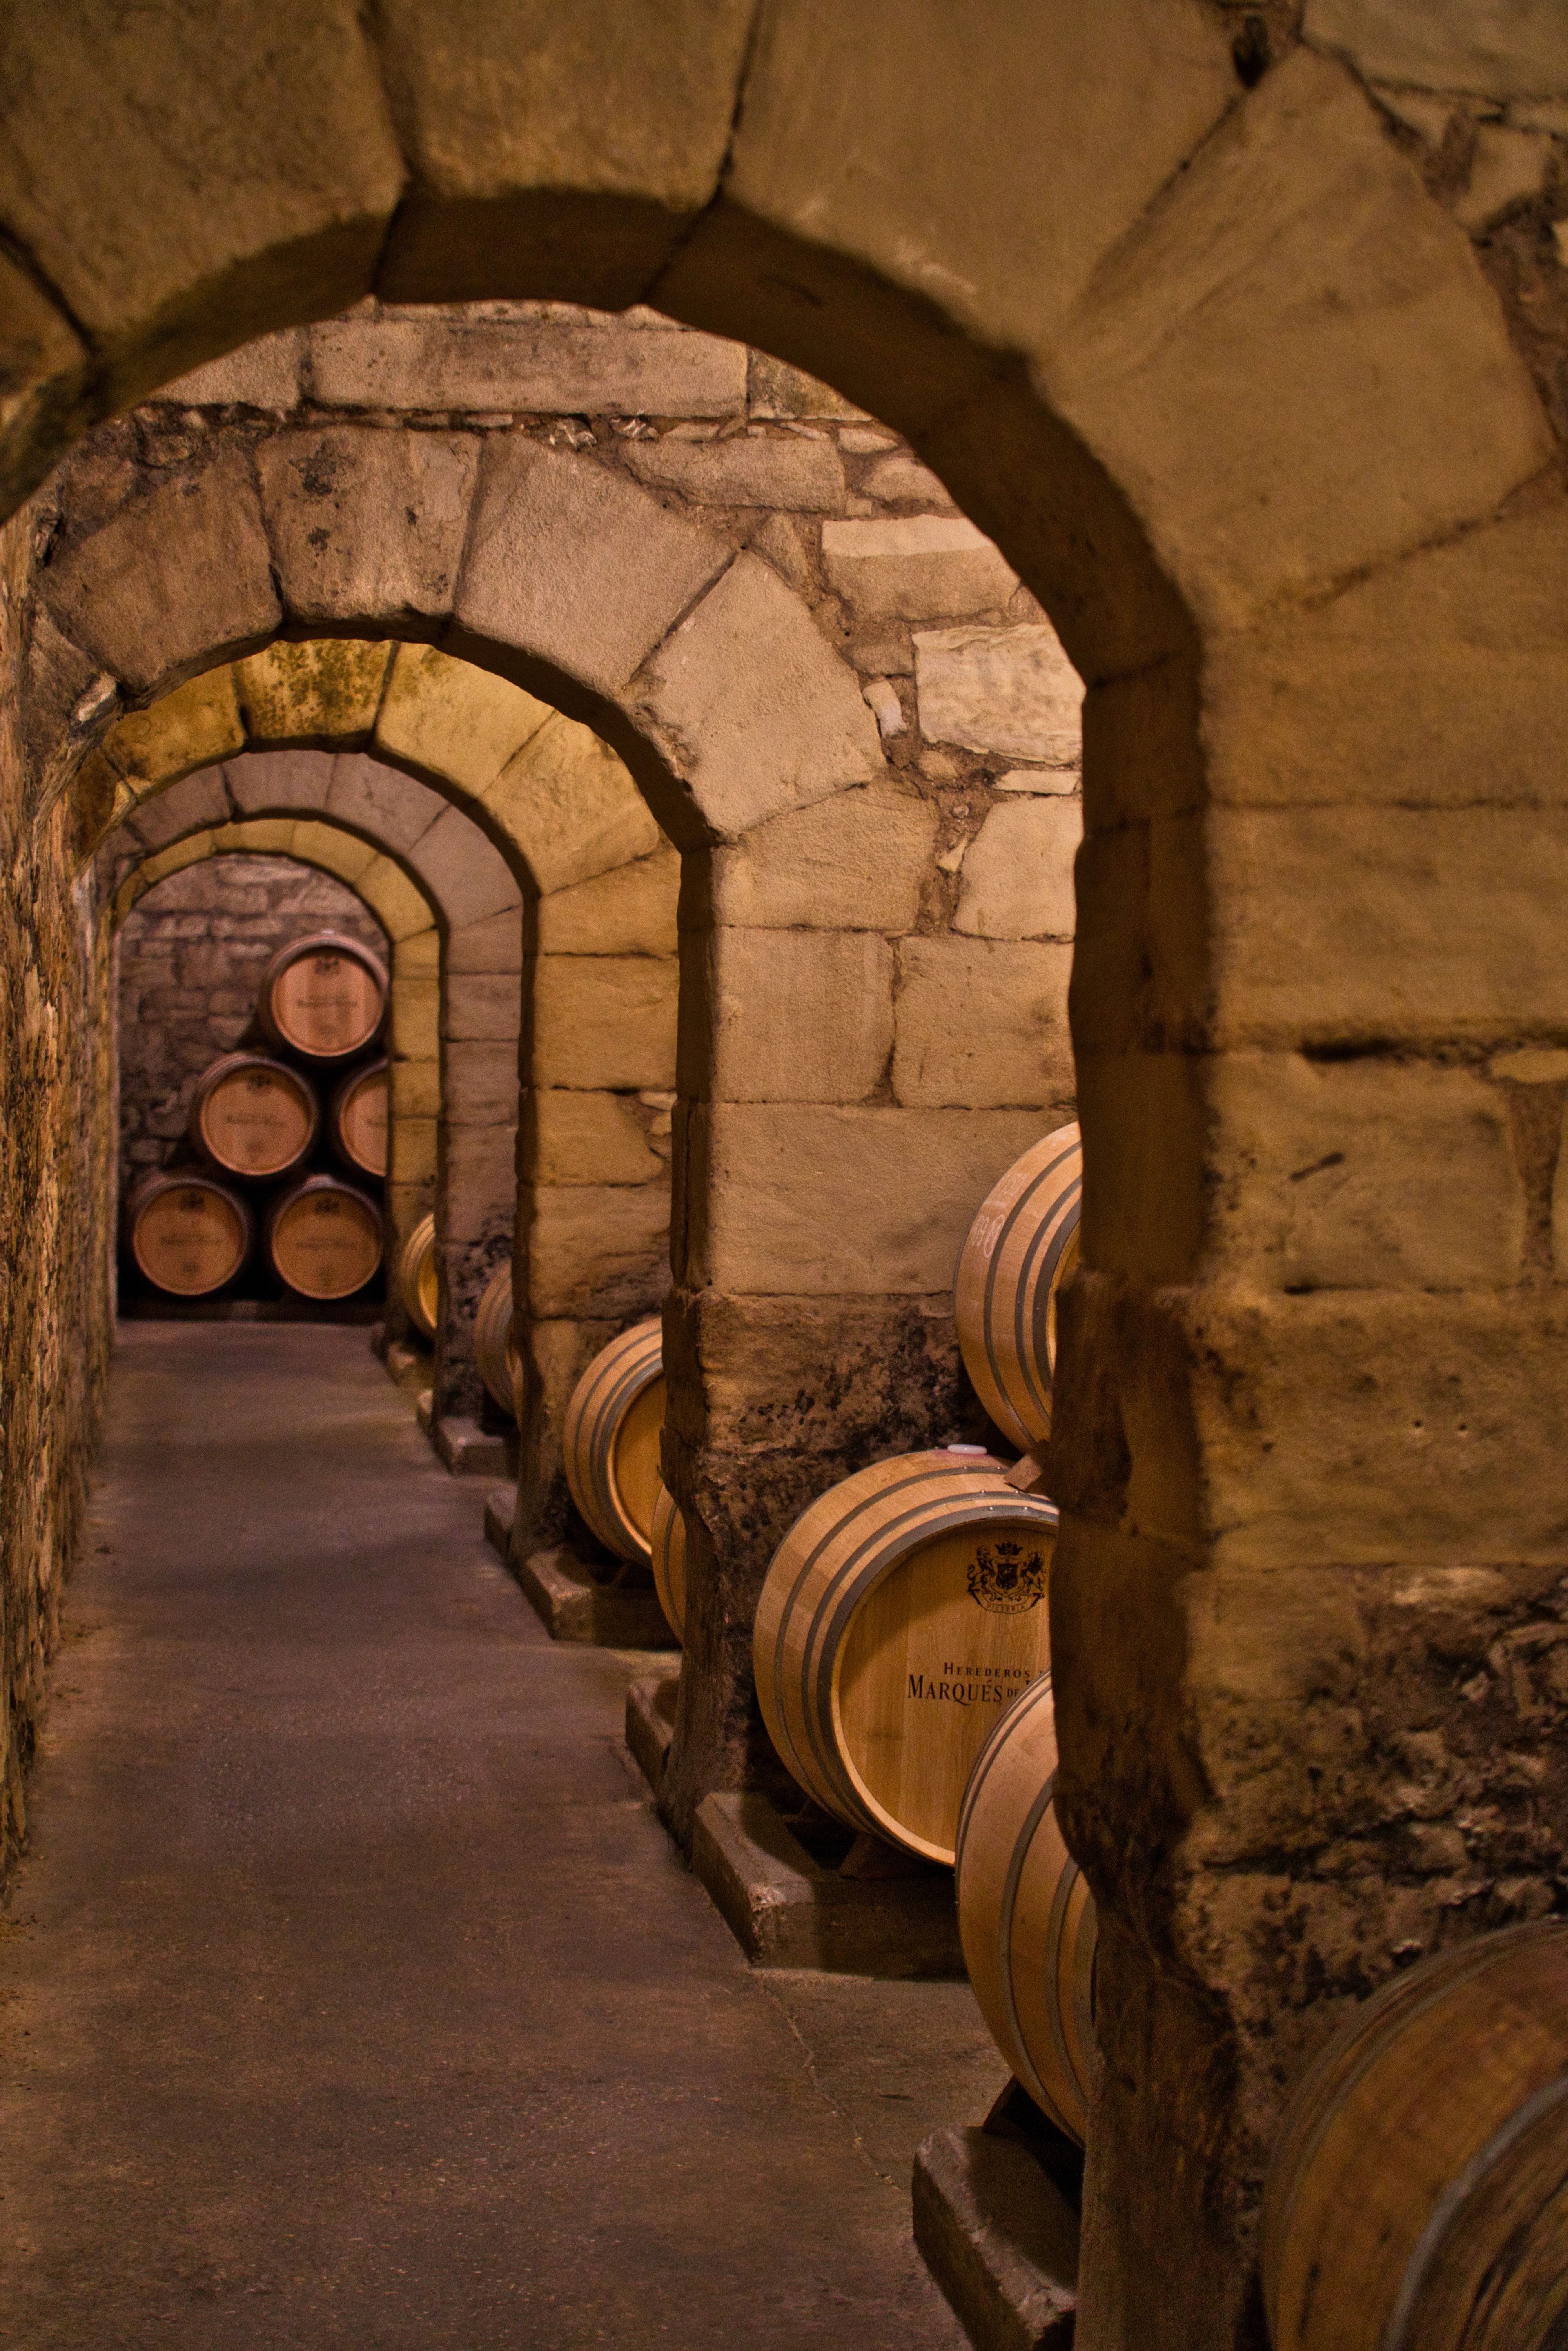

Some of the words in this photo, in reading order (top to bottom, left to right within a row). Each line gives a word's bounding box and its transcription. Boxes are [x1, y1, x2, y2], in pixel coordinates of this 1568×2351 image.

[986, 1603, 1025, 1612] VICTORIA
[944, 1662, 1031, 1678] HEREDEROS
[908, 1674, 1002, 1706] MARQUÉS
